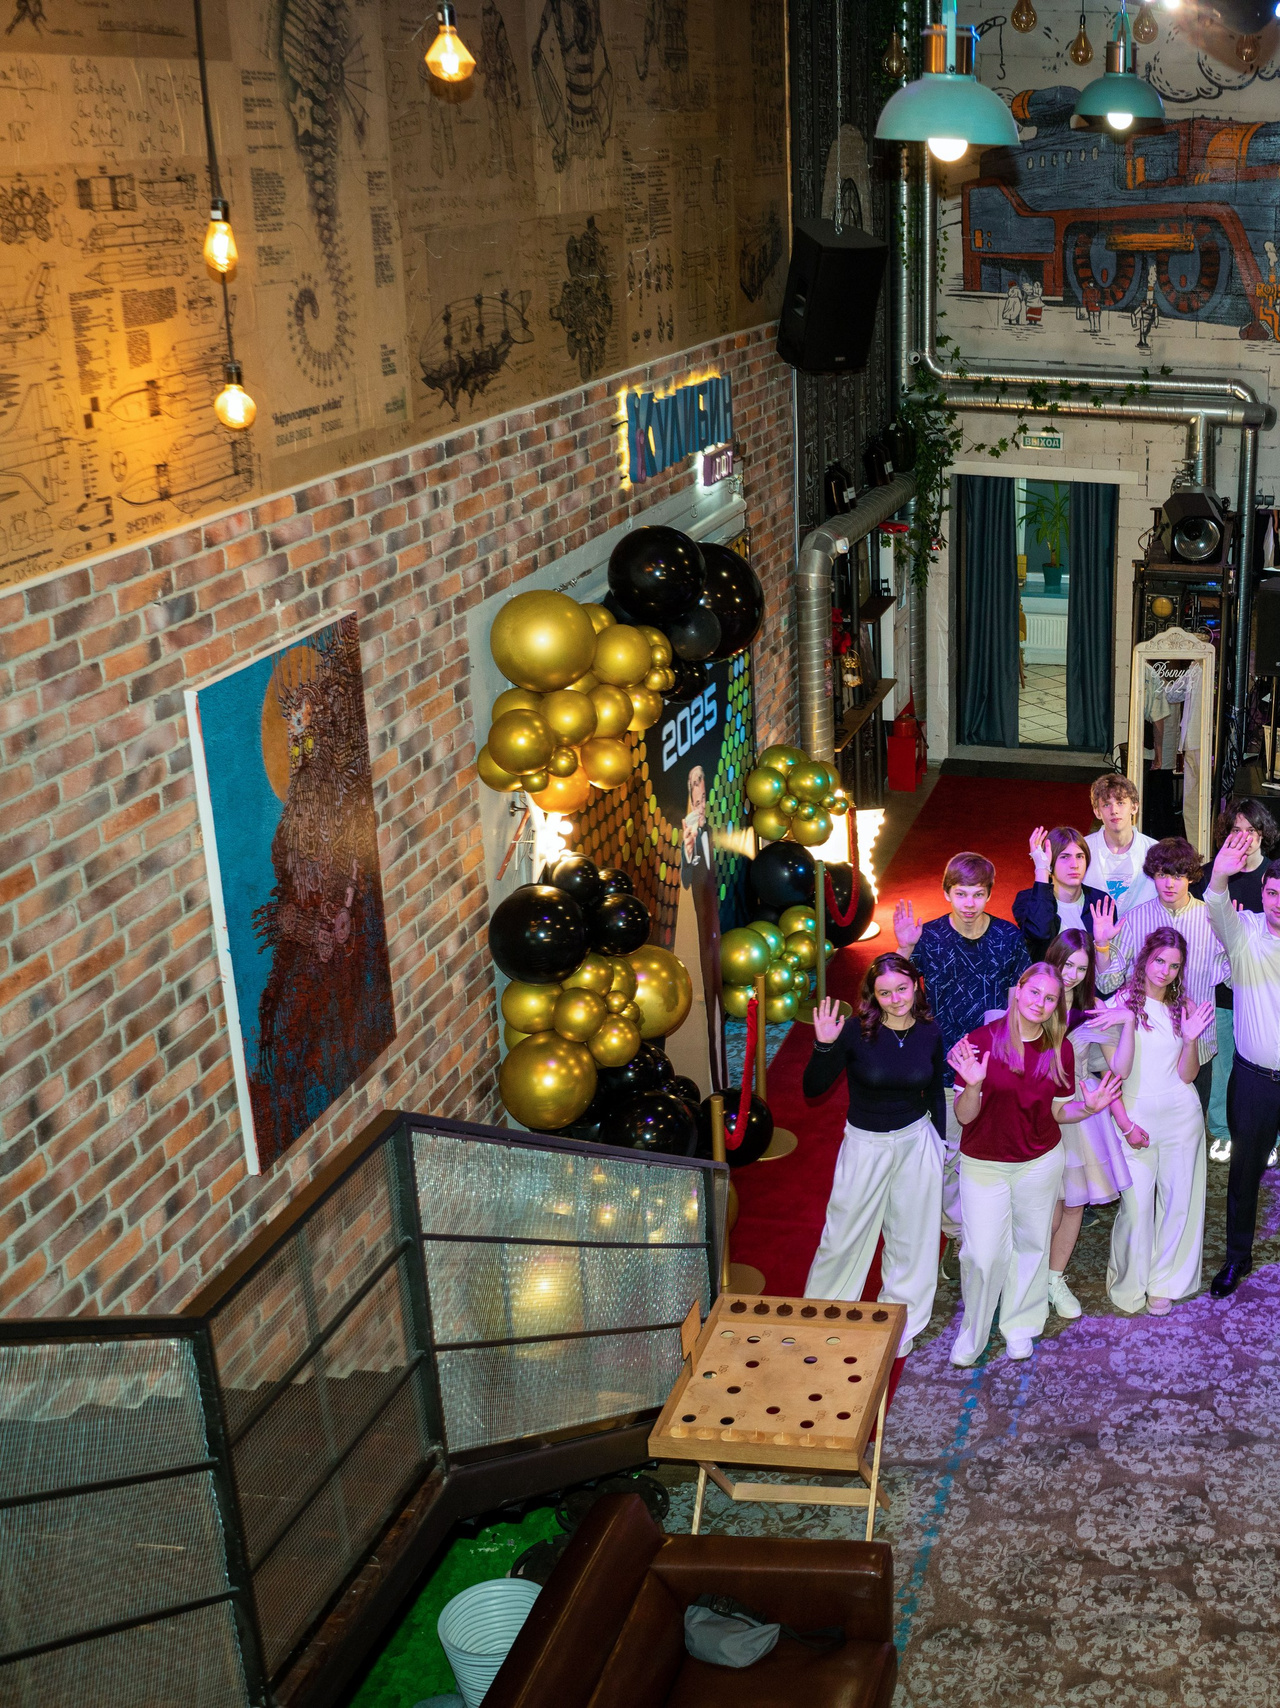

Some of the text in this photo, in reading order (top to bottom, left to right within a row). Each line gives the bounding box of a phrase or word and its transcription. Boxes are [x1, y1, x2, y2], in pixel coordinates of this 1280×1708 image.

[627, 375, 734, 483] КУЛИБИН
[1025, 437, 1060, 447] ВЫХОД
[1151, 661, 1199, 682] Выпуск
[1154, 679, 1195, 694] 2025
[662, 682, 718, 772] 2025
